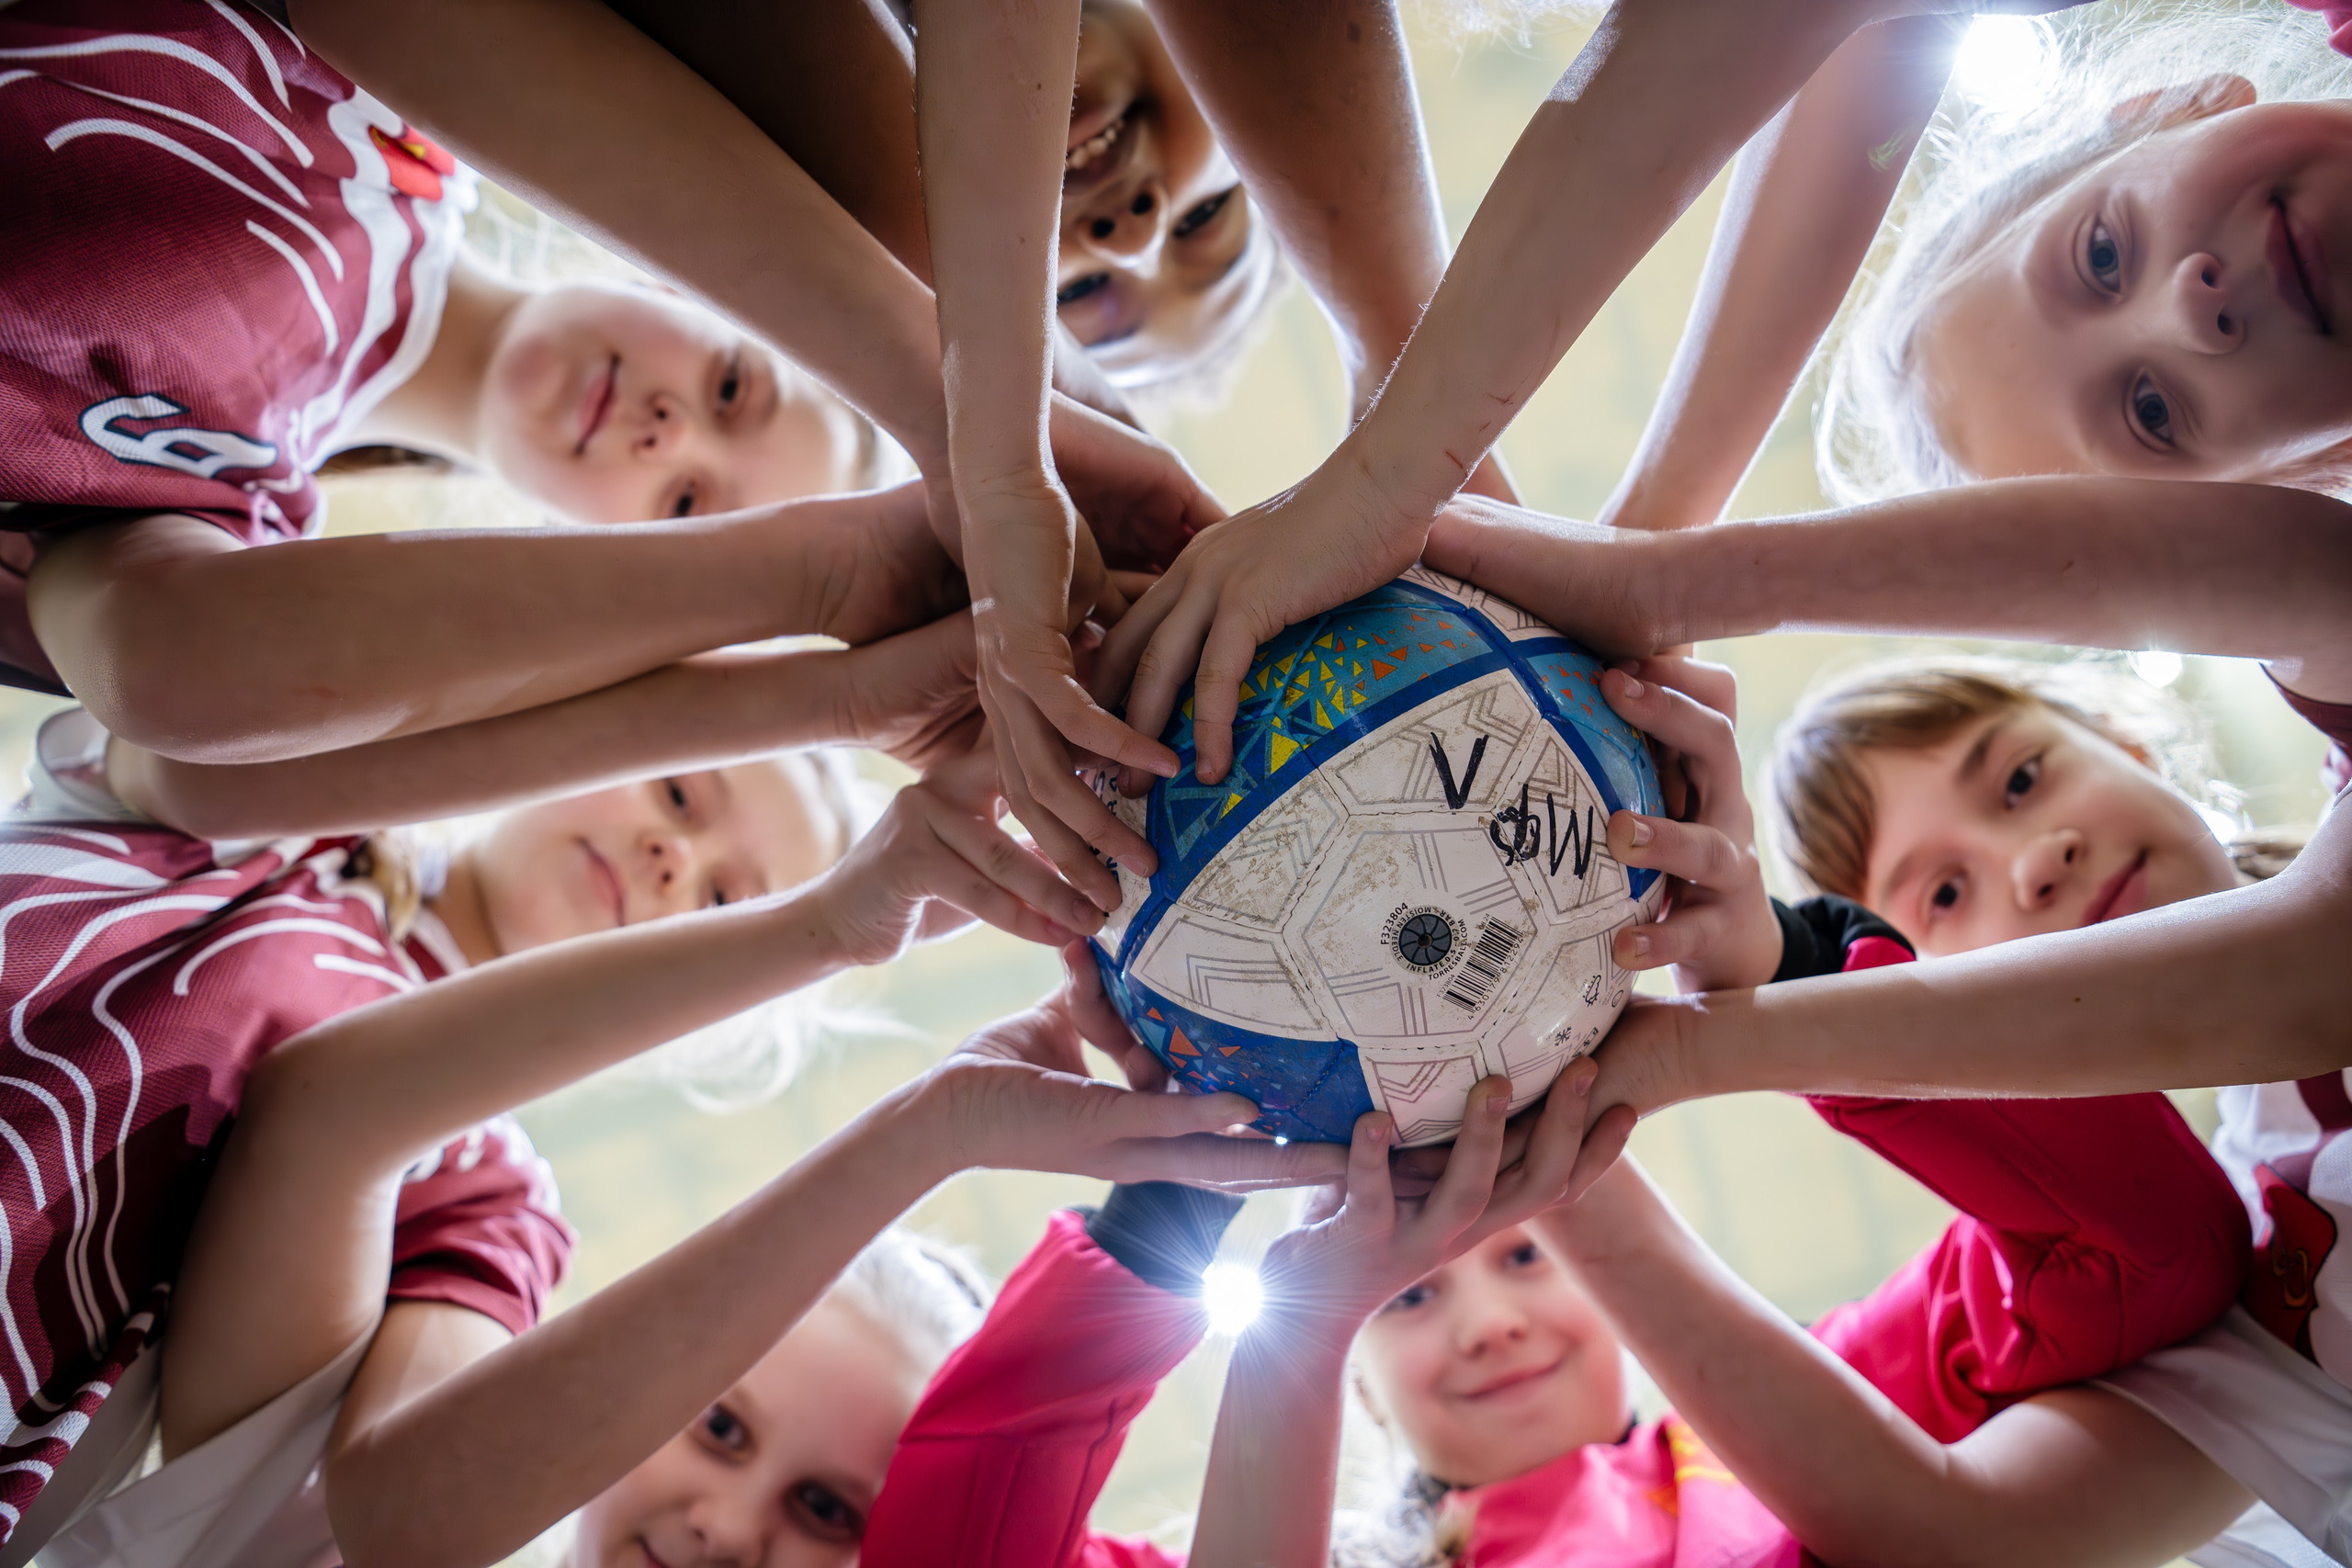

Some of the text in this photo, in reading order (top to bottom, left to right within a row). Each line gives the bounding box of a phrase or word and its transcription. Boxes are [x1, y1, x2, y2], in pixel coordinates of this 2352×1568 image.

[79, 391, 279, 479] 6
[1380, 902, 1408, 945] F323804
[1391, 906, 1431, 962] MOISTEN NEEDLE
[1406, 960, 1445, 973] INFLATE
[1439, 909, 1455, 927] BAR
[1429, 919, 1468, 981] TORRESBALL.COM
[1436, 974, 1455, 998] F323804
